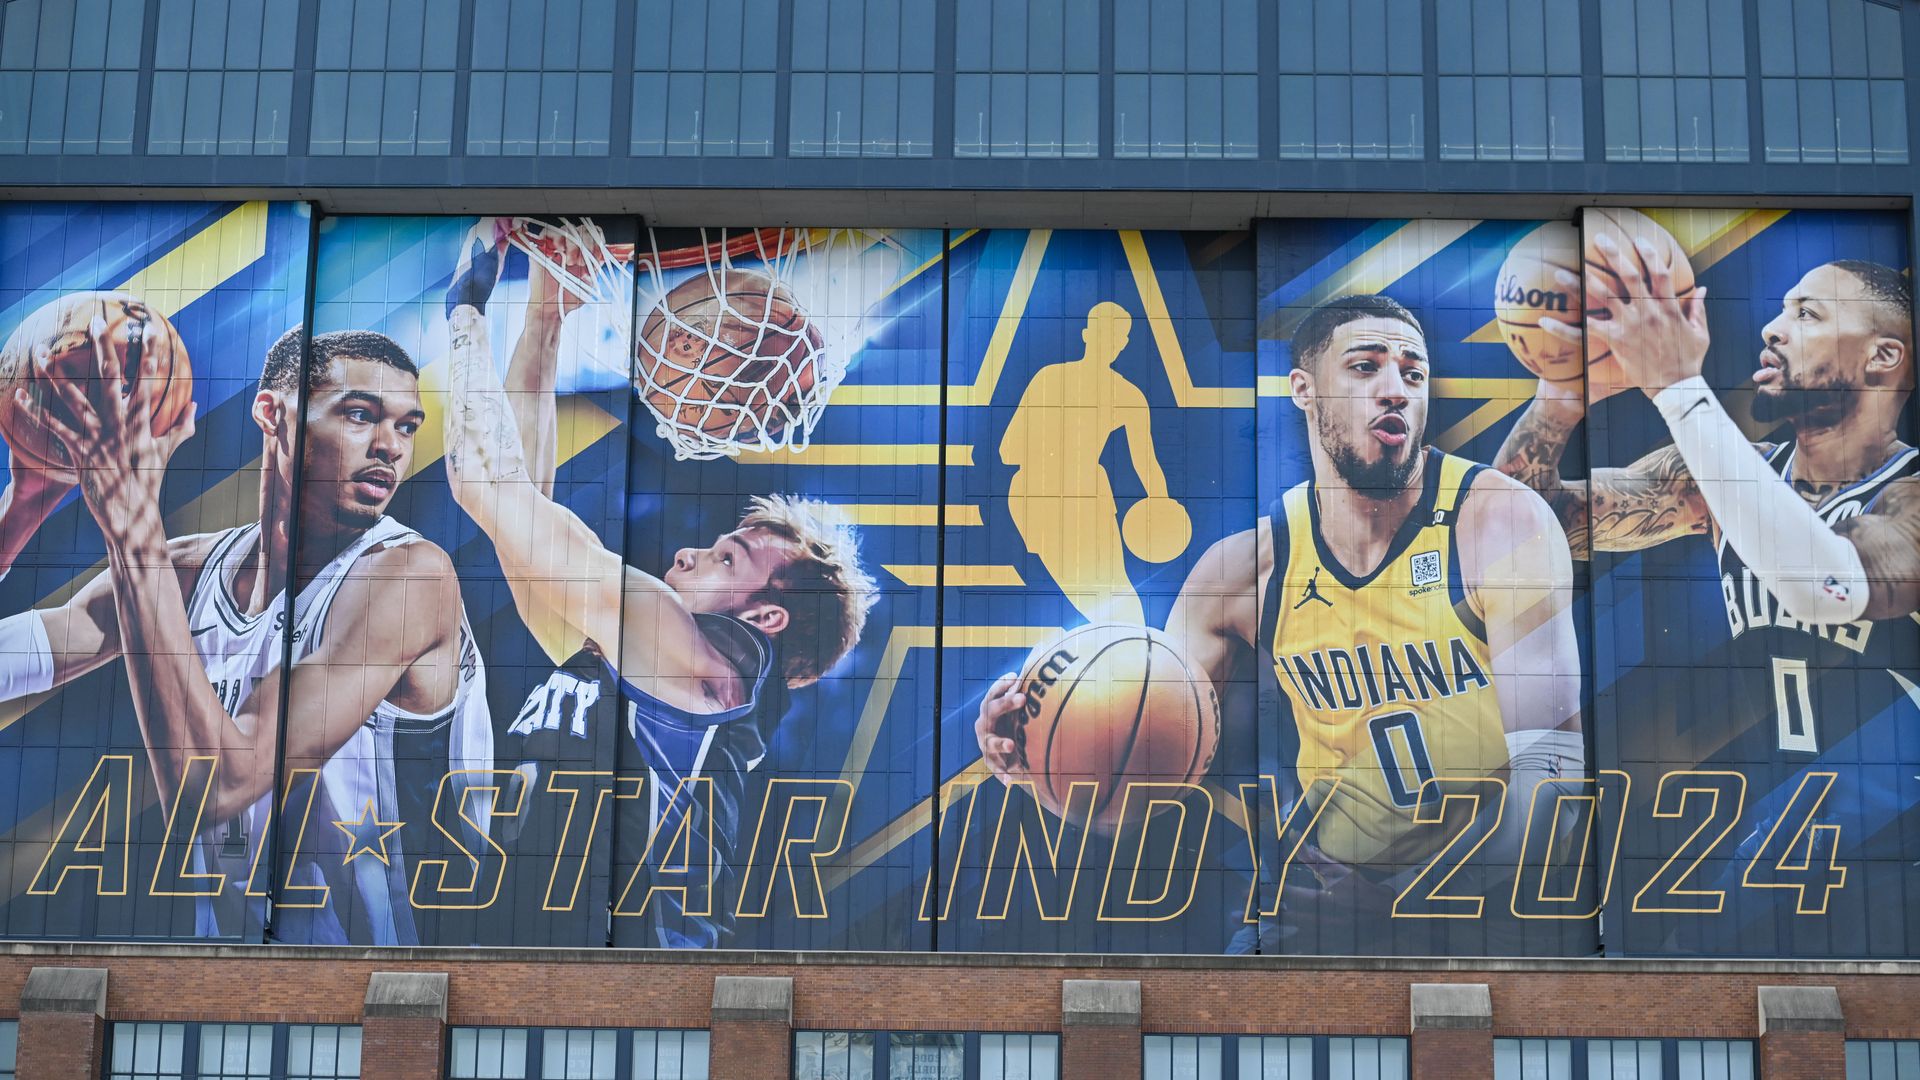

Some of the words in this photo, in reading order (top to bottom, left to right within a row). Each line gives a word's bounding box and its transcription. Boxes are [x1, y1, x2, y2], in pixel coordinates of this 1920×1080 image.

[1279, 637, 1491, 712] INDIANA
[1771, 656, 1819, 754] 0
[1367, 710, 1442, 809] 0
[26, 754, 331, 908] ALL
[409, 769, 854, 919] STAR
[917, 774, 1342, 924] INDY
[1391, 769, 1848, 919] 2024
